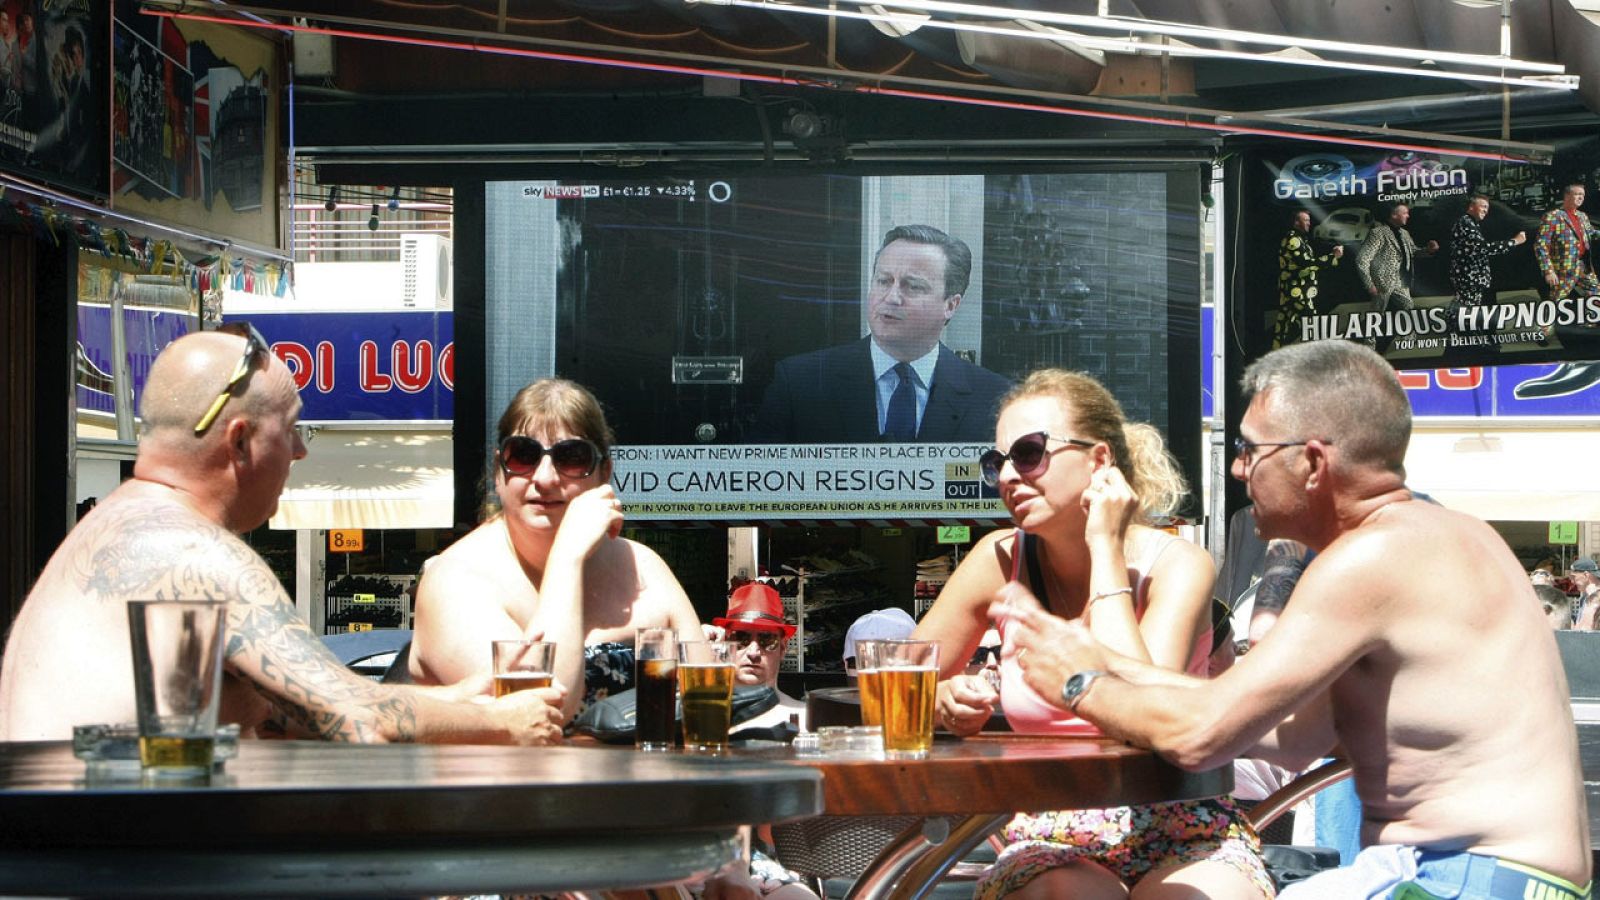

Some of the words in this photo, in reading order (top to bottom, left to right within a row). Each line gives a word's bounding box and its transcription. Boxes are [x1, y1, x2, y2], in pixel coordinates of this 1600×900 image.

[524, 185, 542, 198] sky
[545, 186, 581, 197] NEWS
[583, 186, 598, 197] HD
[1273, 175, 1367, 200] Gareth
[1376, 169, 1467, 193] Fulton
[1377, 190, 1417, 202] Comedy
[1420, 186, 1468, 200] Hypnotist
[1301, 307, 1448, 342] HILARIOUS
[1457, 296, 1600, 333] HYPNOSIS
[1395, 340, 1414, 351] YOU
[1417, 337, 1448, 350] WON'T
[1491, 333, 1518, 345] YOUR
[1520, 331, 1545, 343] EYES
[662, 448, 706, 460] WANT
[708, 448, 741, 460] NEW
[744, 447, 787, 459] PRIME
[790, 446, 858, 459] MINISTER
[861, 446, 876, 459] IN
[879, 446, 925, 458] PLACE
[928, 445, 946, 458] BY
[955, 465, 969, 477] IN
[667, 470, 805, 493] CAMERON
[815, 469, 935, 492] RESIGNS
[947, 484, 978, 496] OUT
[642, 504, 654, 512] IN
[656, 504, 695, 512] VOTING
[699, 504, 712, 512] TO
[715, 504, 746, 512] LEAVE
[749, 504, 769, 512] THE
[772, 503, 828, 511] EUROPEAN
[830, 503, 864, 511] UNION
[867, 503, 881, 511] AS
[884, 503, 897, 511] HE
[900, 503, 943, 511] ARRIVES
[983, 502, 997, 510] UK
